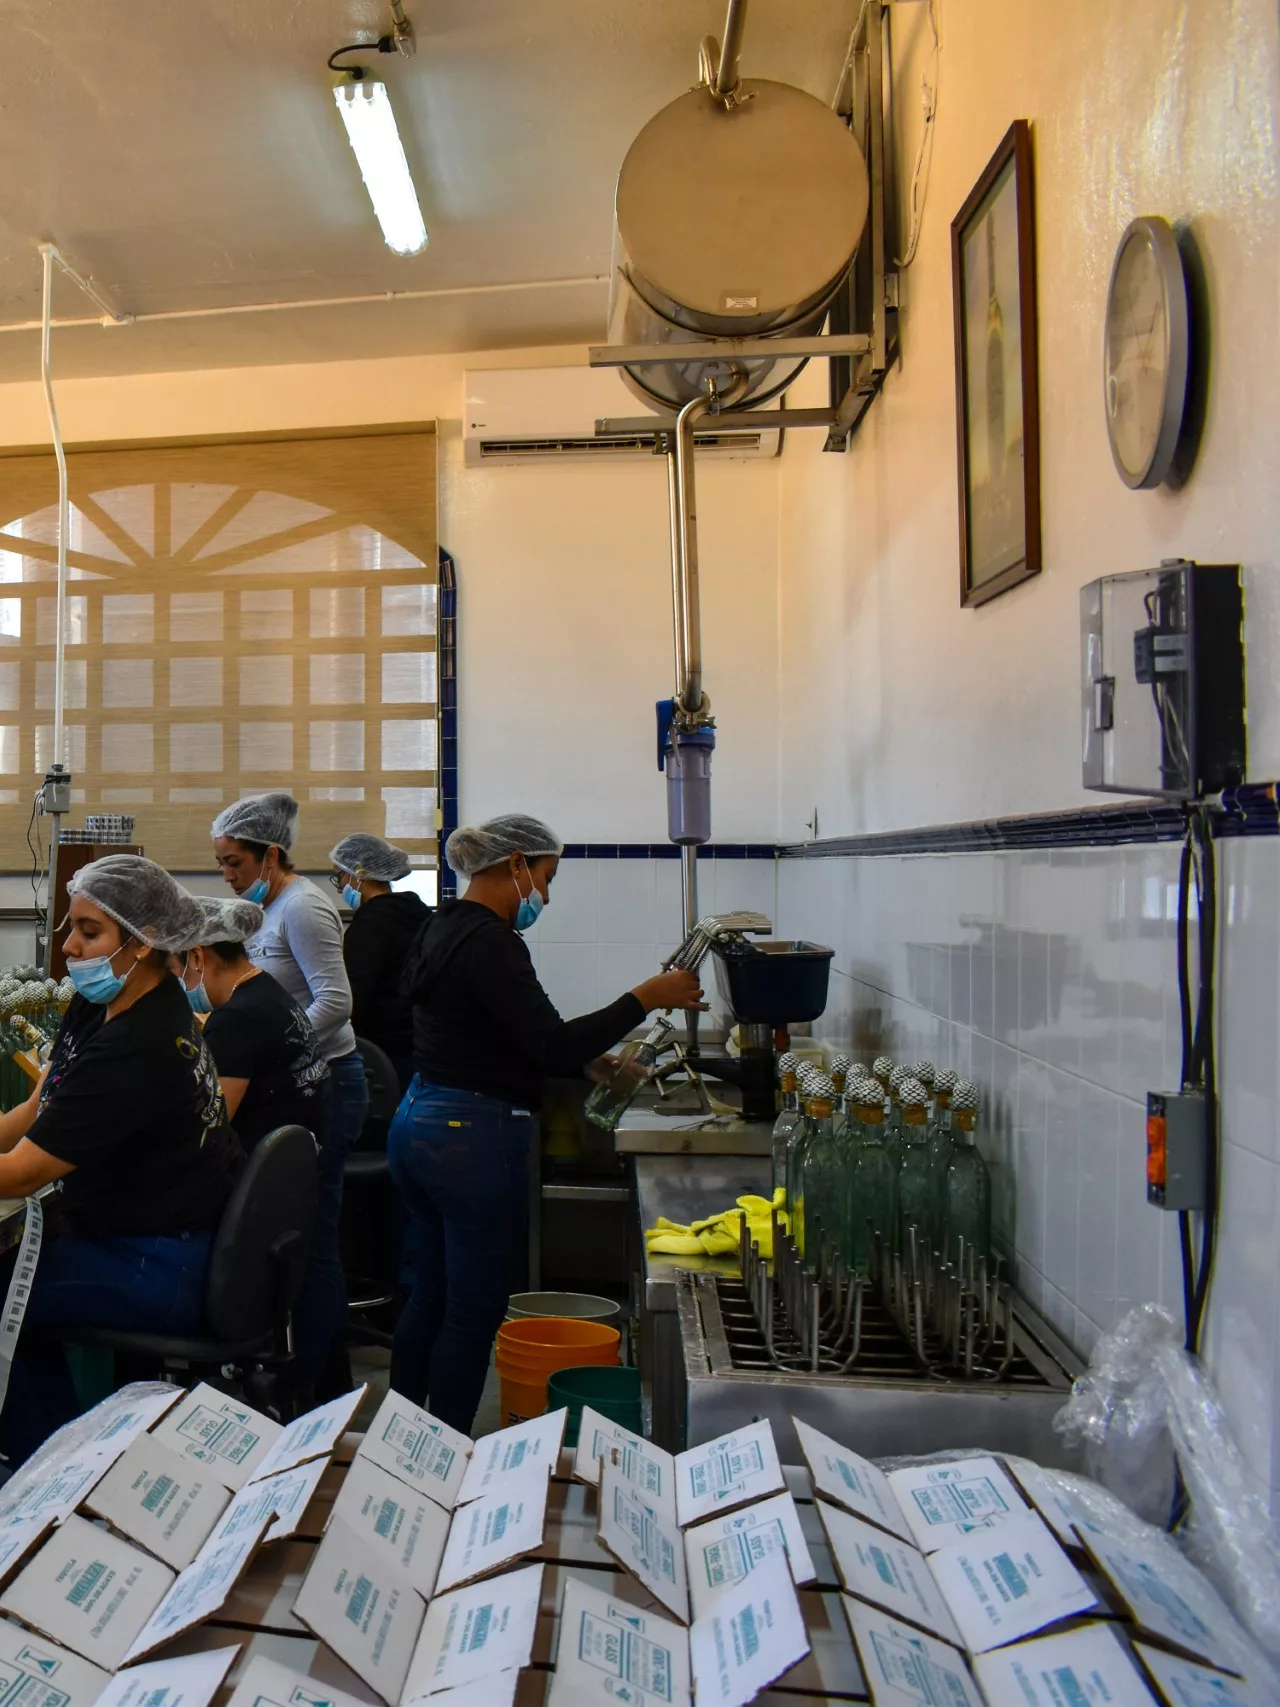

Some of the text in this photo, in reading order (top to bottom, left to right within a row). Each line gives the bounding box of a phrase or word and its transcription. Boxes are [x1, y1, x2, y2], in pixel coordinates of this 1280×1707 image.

[199, 1420, 218, 1438] GLASS
[403, 1430, 417, 1450] GLASS
[750, 1535, 766, 1560] GLASS
[605, 1633, 618, 1664] GLASS
